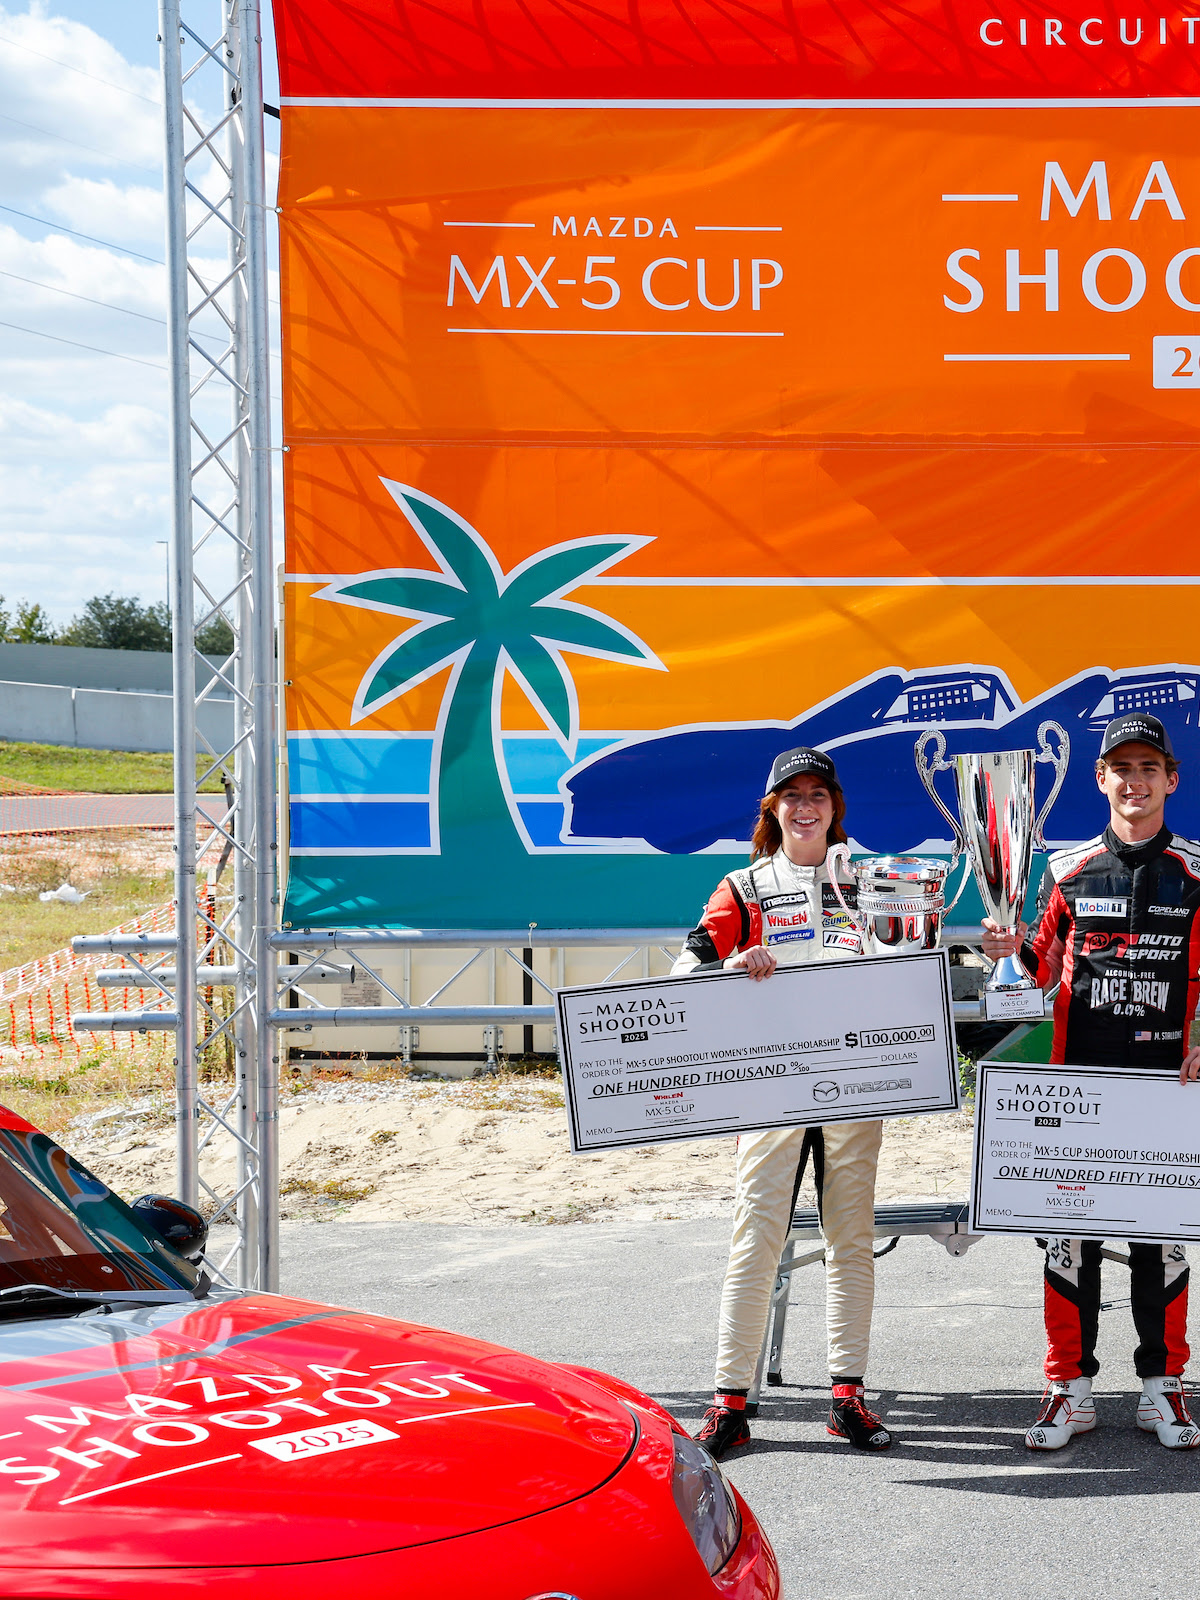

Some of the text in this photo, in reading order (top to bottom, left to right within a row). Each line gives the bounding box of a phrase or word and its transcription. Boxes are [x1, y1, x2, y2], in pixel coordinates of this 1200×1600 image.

[979, 17, 1200, 46] CIRCUIT
[552, 216, 679, 238] MAZDA
[447, 254, 784, 311] MX-5 CUP
[1111, 727, 1159, 739] MOTORSPORTS
[781, 759, 829, 771] MOTORSPORTS
[763, 894, 806, 910] mazda
[1080, 903, 1122, 913] Mobil 1
[1148, 906, 1190, 915] COPELAND
[767, 911, 807, 927] WHELEN
[778, 932, 811, 941] MICHELIN
[1138, 934, 1184, 946] AUTO
[1124, 949, 1181, 960] SPORT
[1105, 970, 1156, 979] ALCOHOL-FREE
[1090, 978, 1170, 1013] RACE BREW
[596, 998, 667, 1016] MAZDA
[1113, 1004, 1145, 1017] 0.0%
[580, 1011, 686, 1034] SHOOTOUT
[624, 1033, 646, 1041] 2025
[845, 1028, 932, 1048] $ 100,000.00
[626, 1038, 840, 1069] MX-5 CUP SHOOTOUT WOMEN'S INITIATIVE SCHOLARSHIP
[881, 1052, 918, 1062] DOLLARS
[580, 1058, 623, 1069] PAY TO THE
[582, 1070, 610, 1079] ORDER
[592, 1082, 623, 1096] ONE
[628, 1073, 701, 1092] HUNDRED
[705, 1063, 787, 1082] THOUSAND
[844, 1078, 912, 1095] mazda
[1015, 1084, 1083, 1098] MAZDA
[654, 1092, 683, 1100] WHELEN
[645, 1104, 695, 1117] MX-5 CUP
[996, 1099, 1101, 1115] SHOOTOUT
[1038, 1118, 1059, 1126] 2025
[586, 1127, 613, 1136] MEMO
[990, 1140, 1004, 1148] PAY
[1035, 1146, 1060, 1156] MX-5
[1062, 1147, 1082, 1157] CUP
[1085, 1148, 1138, 1160] SHOOTOUT
[999, 1166, 1029, 1178] ONE
[1033, 1167, 1105, 1181] HUNDRED
[1109, 1171, 1144, 1183] FIFTY
[1046, 1198, 1095, 1207] MX-5 CUP
[25, 1363, 370, 1434] MAZDA
[0, 1373, 492, 1485] SHOOTOUT
[276, 1426, 375, 1454] 2025
